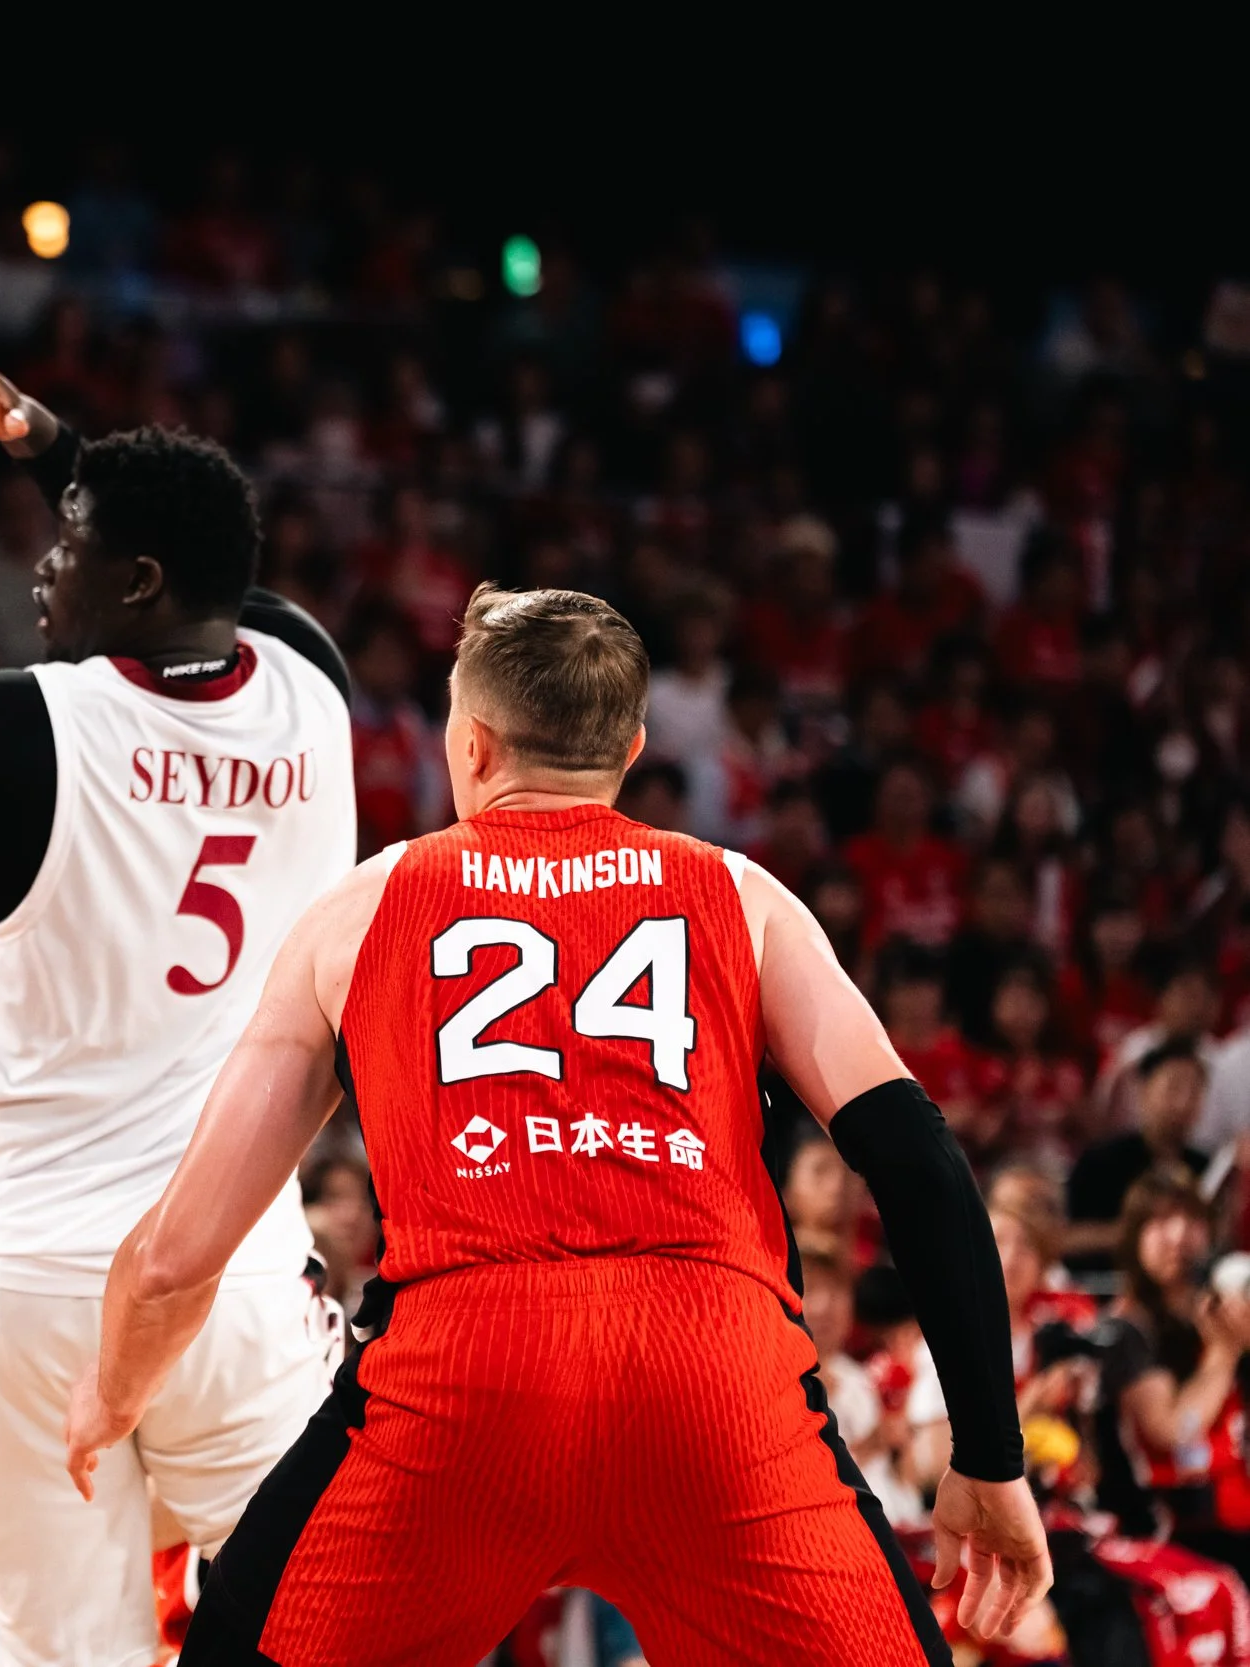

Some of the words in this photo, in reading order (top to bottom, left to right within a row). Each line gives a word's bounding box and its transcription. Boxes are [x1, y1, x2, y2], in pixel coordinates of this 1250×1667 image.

[163, 663, 201, 678] NIKE
[129, 747, 318, 809] SEYDOU
[461, 848, 663, 899] HAWKINSON
[166, 835, 258, 997] 5
[430, 915, 698, 1093] 24
[456, 1161, 511, 1180] NISSAY
[525, 1112, 706, 1171] 日本生命
